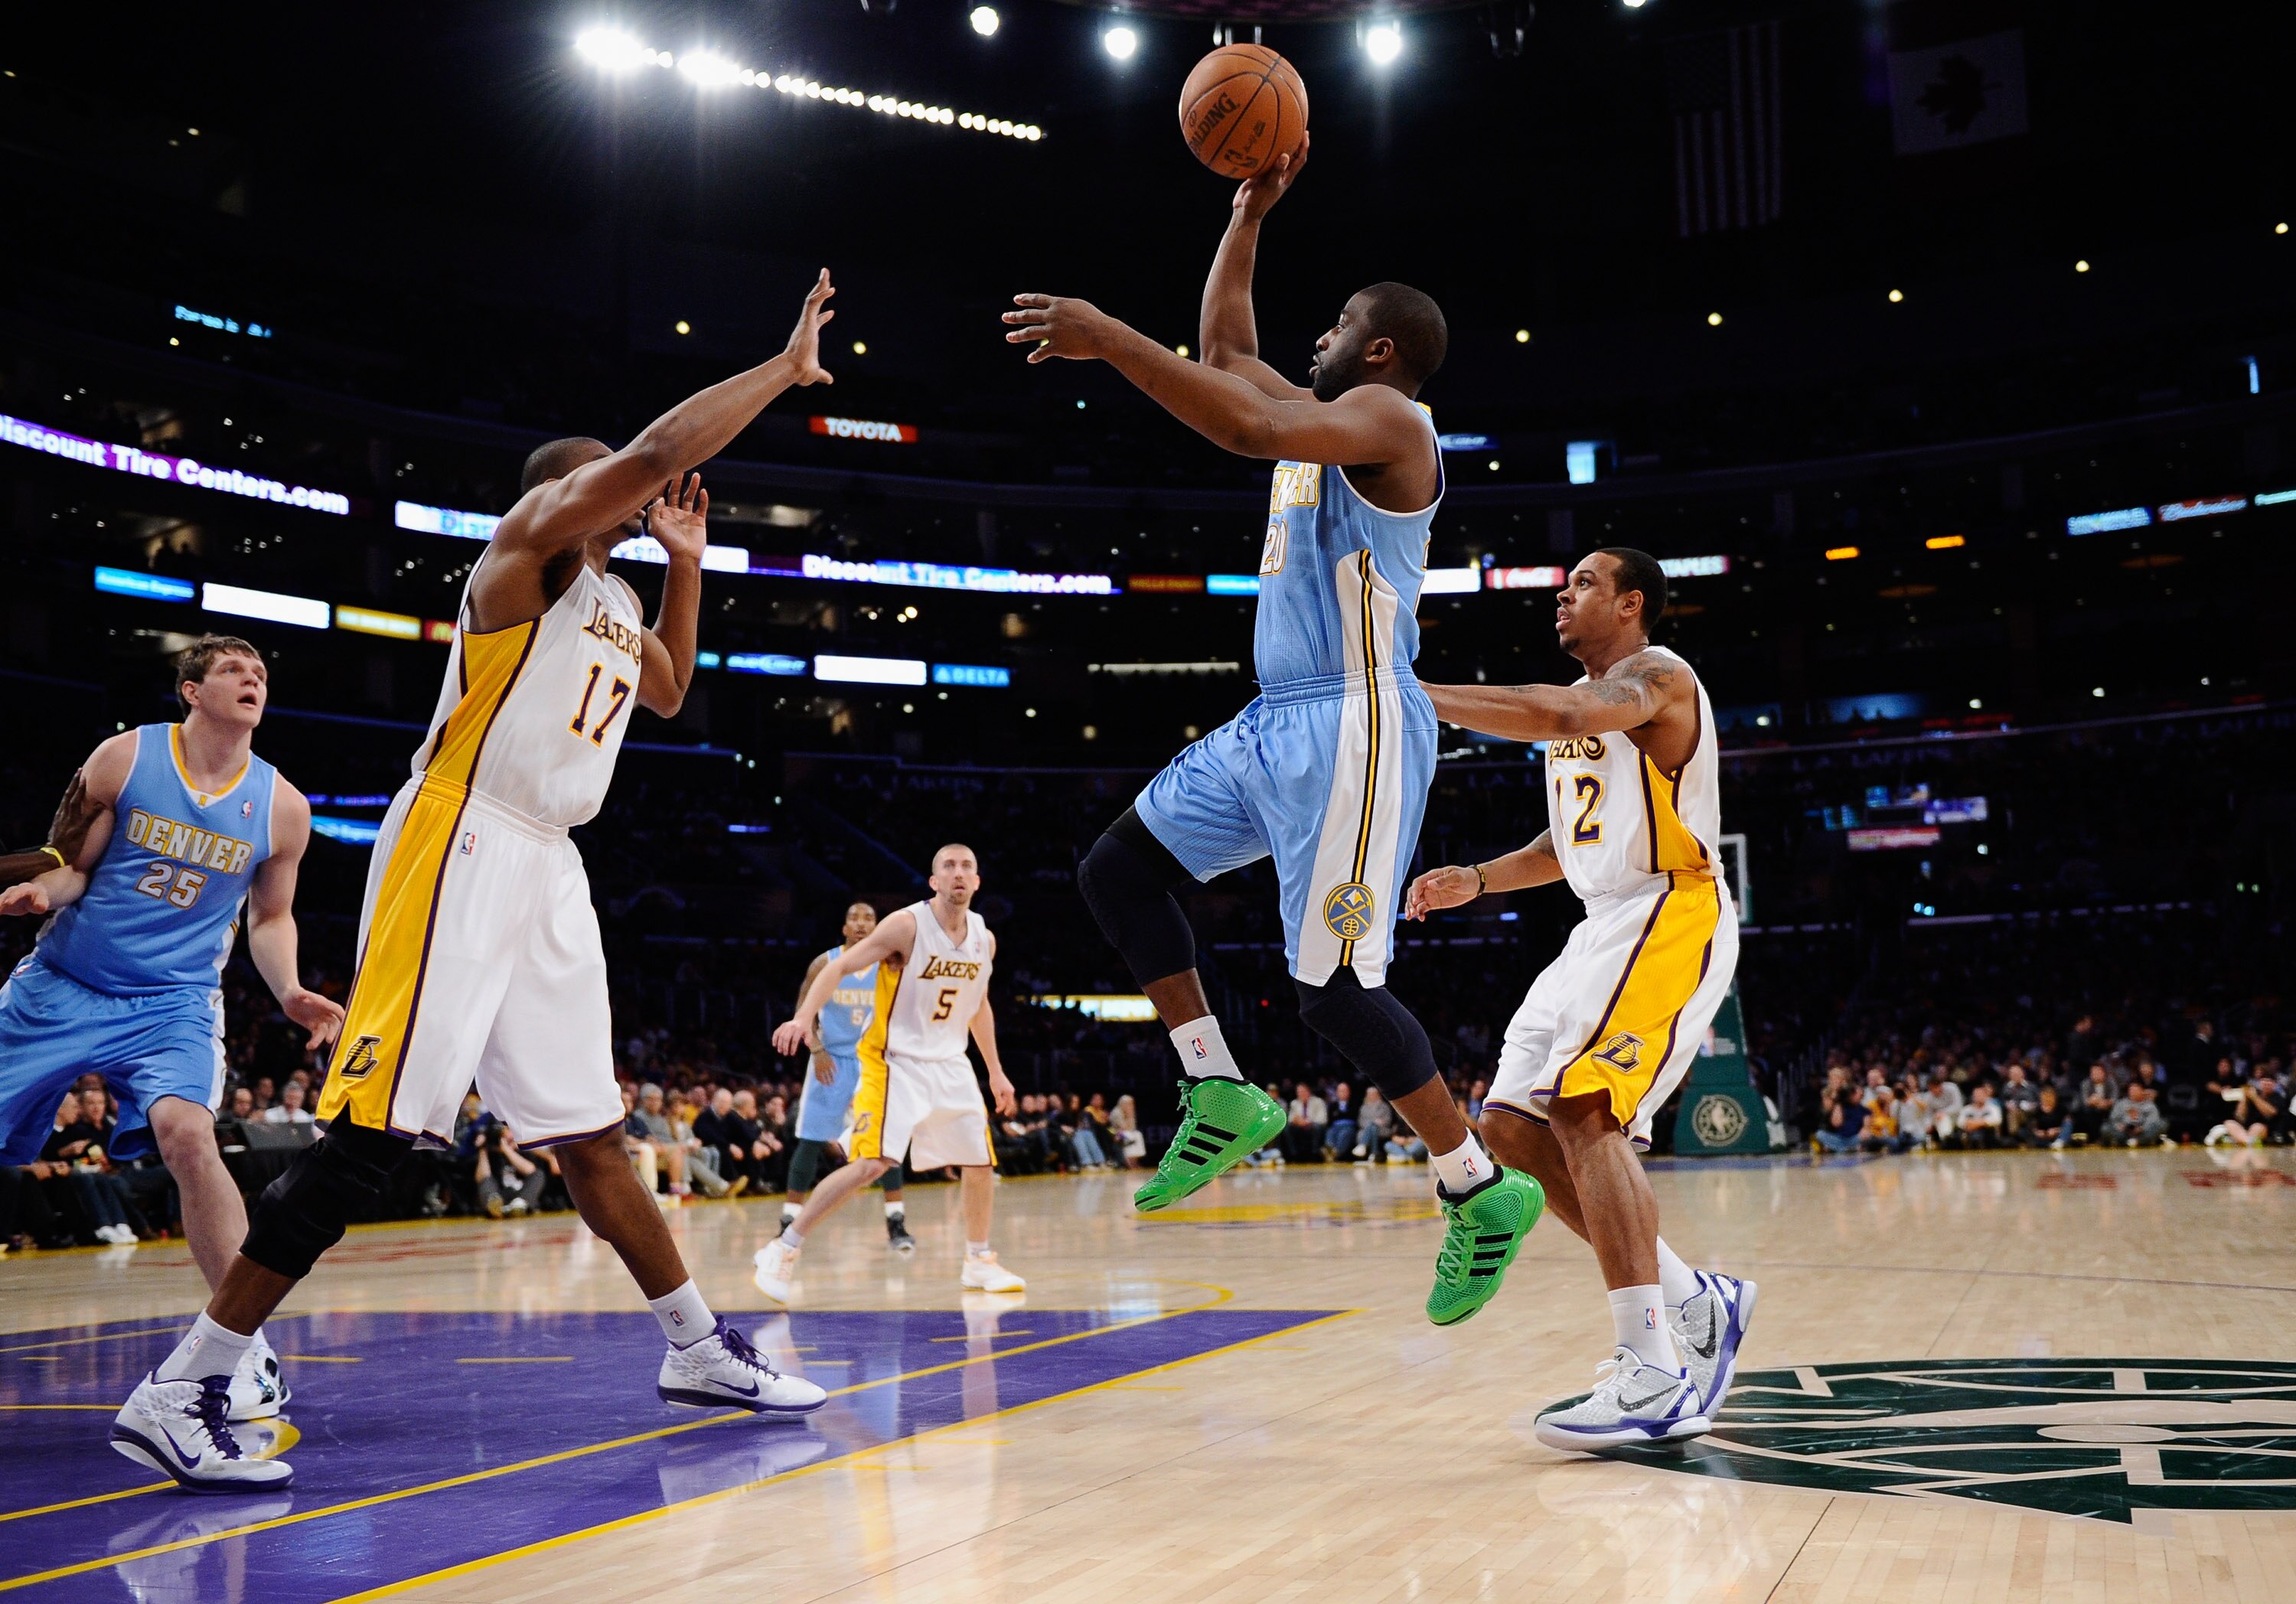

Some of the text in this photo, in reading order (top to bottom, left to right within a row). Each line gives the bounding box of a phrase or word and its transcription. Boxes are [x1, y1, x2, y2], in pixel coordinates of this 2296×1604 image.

[824, 416, 902, 442] TOYOTA
[111, 443, 171, 480] Tire
[175, 458, 350, 516] Centers.com
[1258, 519, 1288, 576] 20
[802, 554, 909, 583] Discount
[914, 562, 958, 587] Tire
[963, 567, 1112, 595] Centers.com
[951, 667, 1009, 685] DELTA
[569, 661, 632, 748] 17
[126, 807, 255, 875] DENVER
[135, 860, 208, 910] 25
[917, 955, 982, 981] LAKERS
[850, 1008, 864, 1026] 5
[931, 988, 959, 1023] 5
